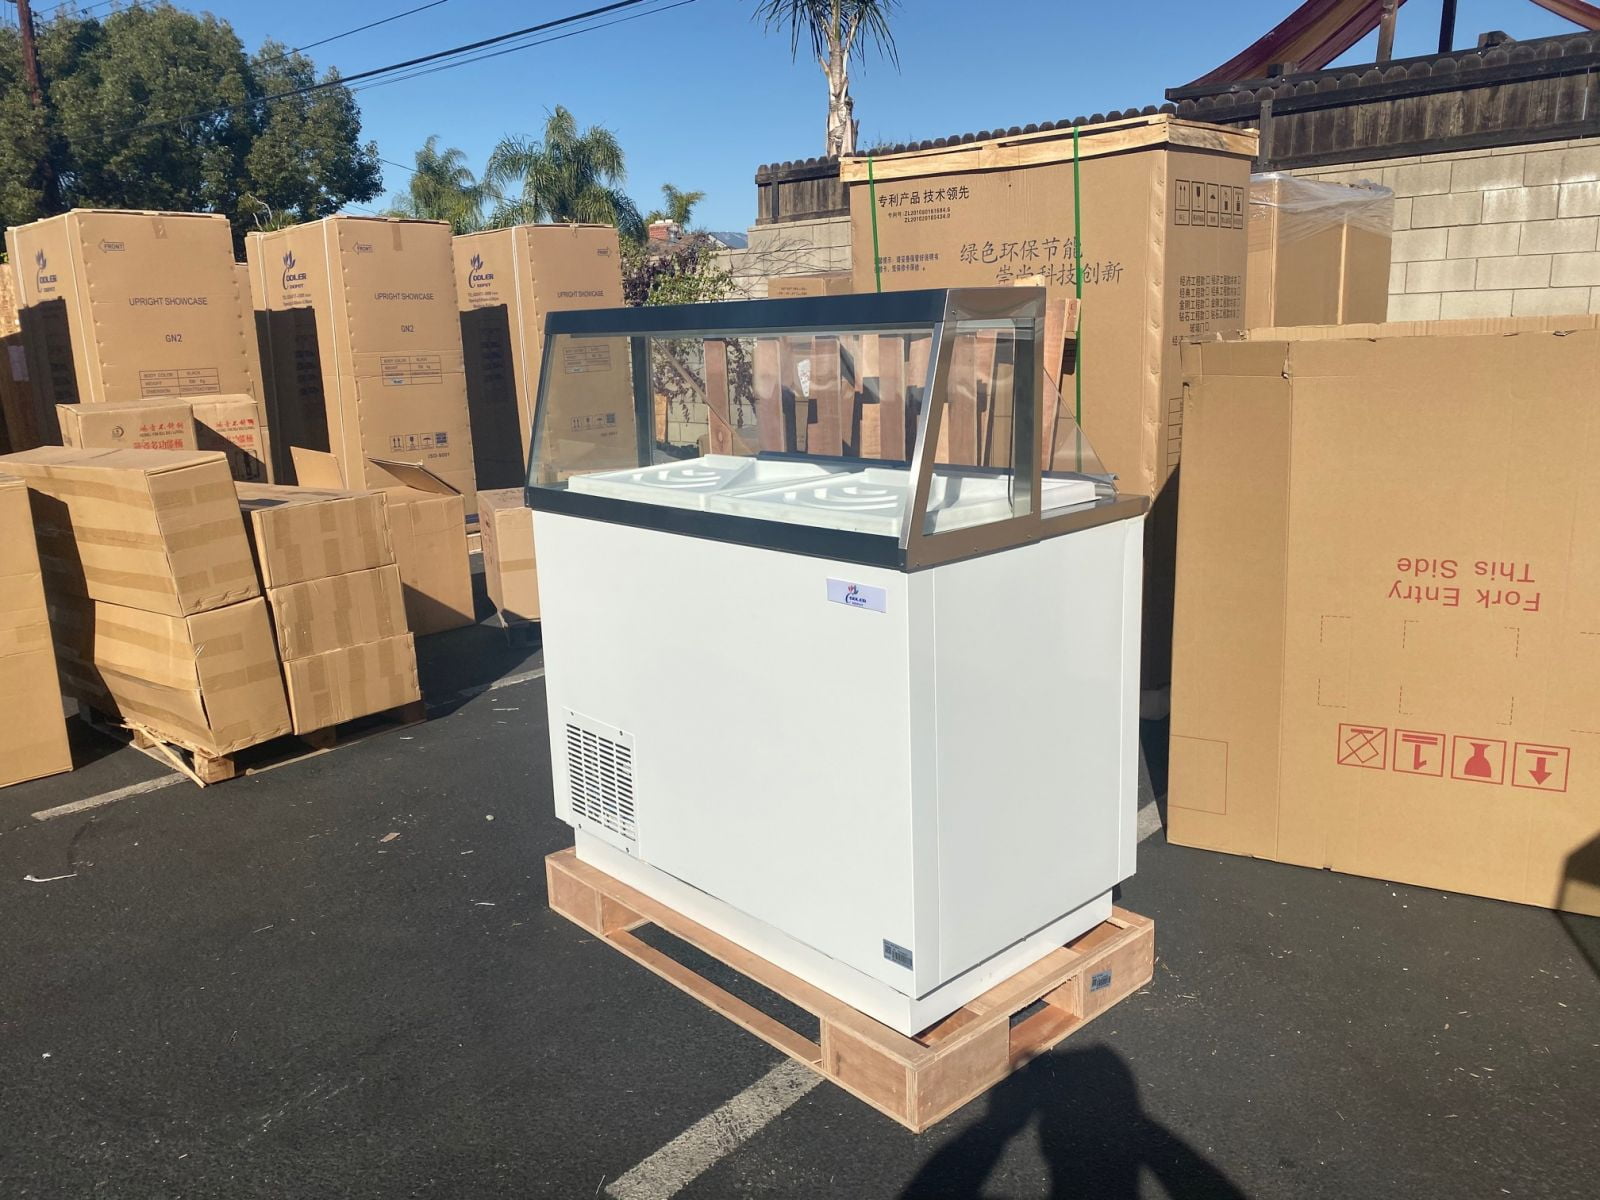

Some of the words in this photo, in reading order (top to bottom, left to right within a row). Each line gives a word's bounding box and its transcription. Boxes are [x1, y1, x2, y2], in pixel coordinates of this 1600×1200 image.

[878, 191, 920, 208] 专利产品
[923, 186, 970, 204] 技术领先
[960, 236, 1083, 265] 绿色环保节能
[129, 297, 163, 306] UPRIGHT
[164, 297, 208, 306] SHOWCASE
[374, 292, 400, 301] UPRIGHT
[401, 292, 434, 301] SHOWCASE
[165, 334, 183, 343] GN2
[1396, 557, 1459, 580] Side
[1473, 560, 1536, 584] This
[1388, 579, 1461, 608] Entry
[1475, 588, 1541, 613] Fork
